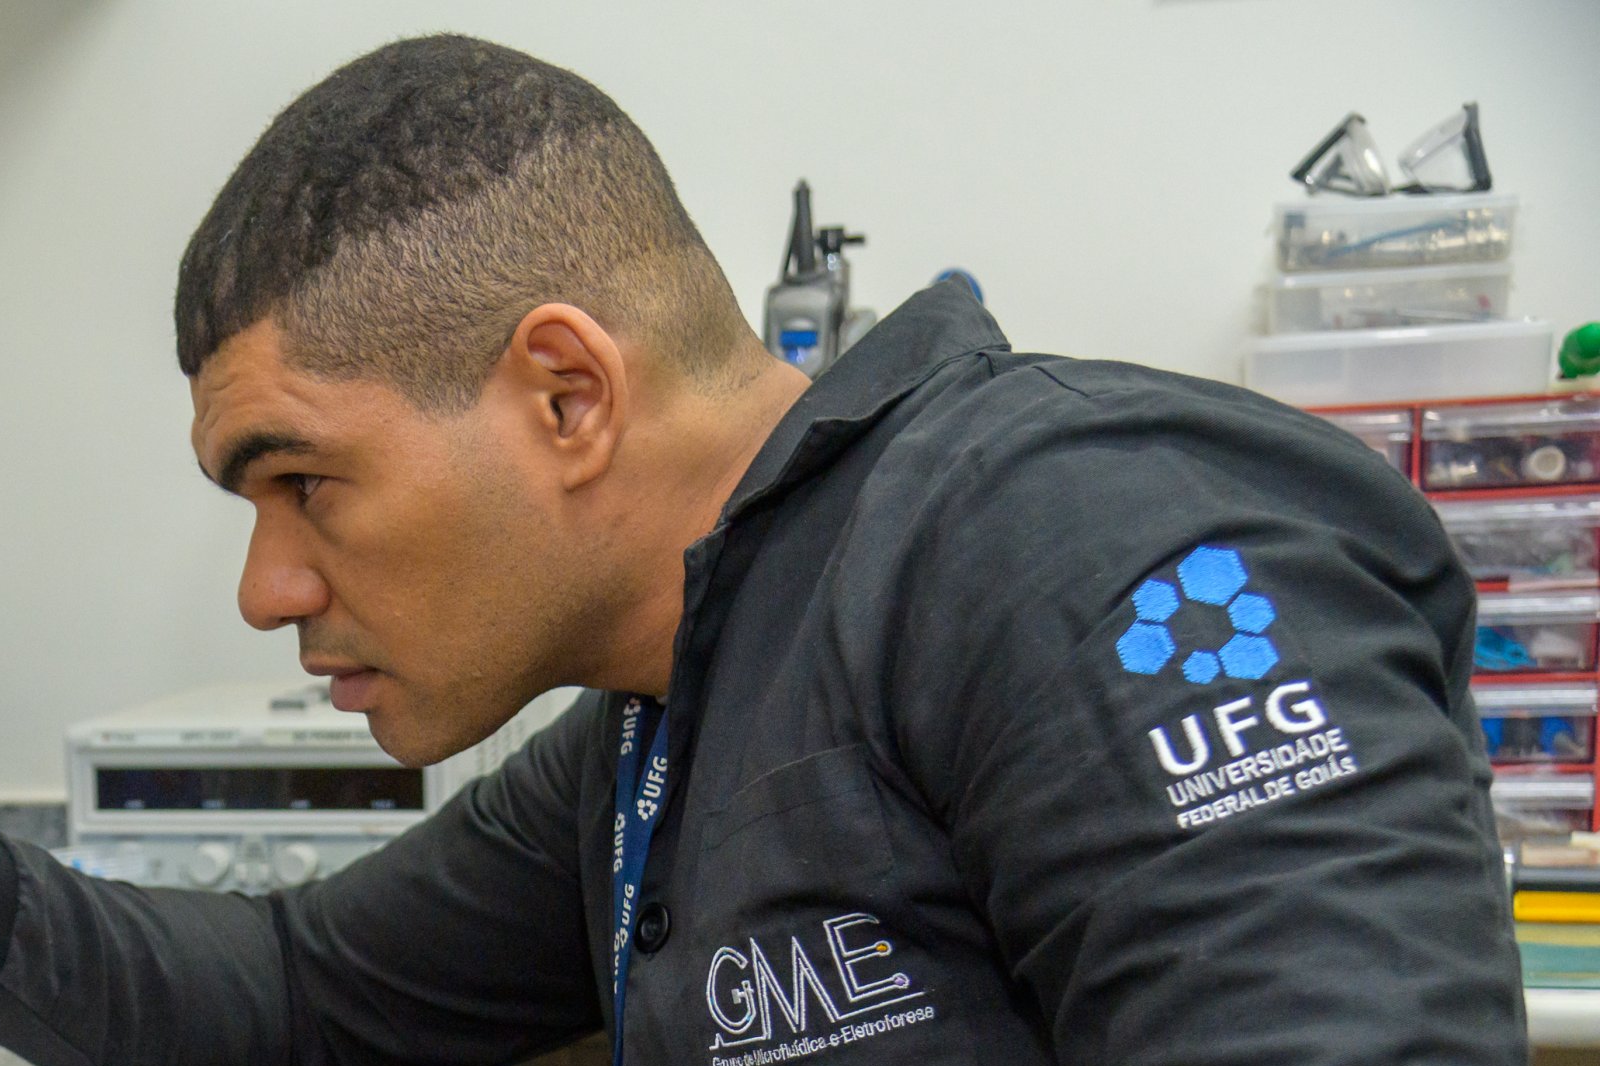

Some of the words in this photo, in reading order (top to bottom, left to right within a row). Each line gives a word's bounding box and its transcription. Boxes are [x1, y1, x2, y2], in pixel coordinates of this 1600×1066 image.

[620, 716, 637, 756] UFG
[1148, 680, 1327, 776] UFG
[643, 756, 668, 799] UFG
[1166, 728, 1349, 807] UNIVERSIDADE
[1176, 787, 1267, 829] FEDERAL
[1264, 775, 1296, 801] DE
[1295, 753, 1358, 790] GOIÁS
[613, 832, 625, 873] UFG
[621, 883, 635, 926] UFG
[706, 912, 910, 1041] GME
